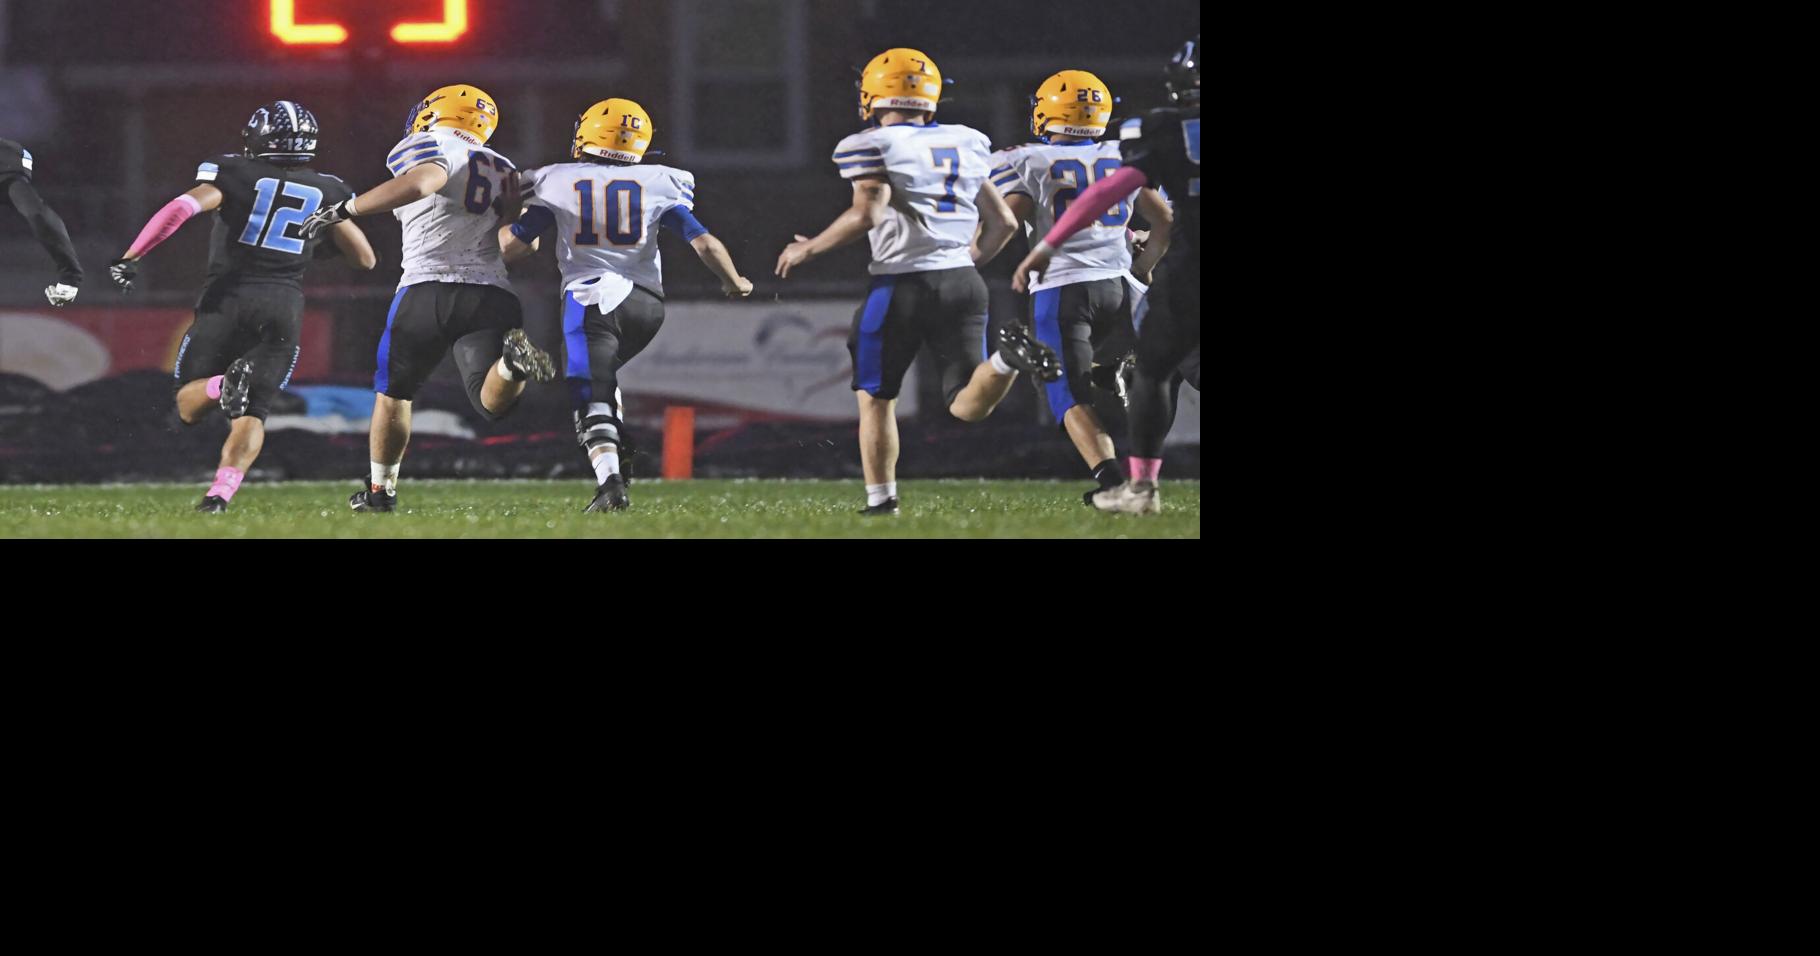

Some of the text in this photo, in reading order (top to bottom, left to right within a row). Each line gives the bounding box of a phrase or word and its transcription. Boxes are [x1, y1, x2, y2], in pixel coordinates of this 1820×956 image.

[910, 57, 927, 73] 7
[1076, 88, 1102, 102] 26
[475, 98, 496, 116] 63
[287, 137, 304, 151] 12
[599, 149, 636, 162] Riddell
[929, 147, 960, 213] 7
[238, 177, 324, 254] 12
[573, 179, 643, 246] 10
